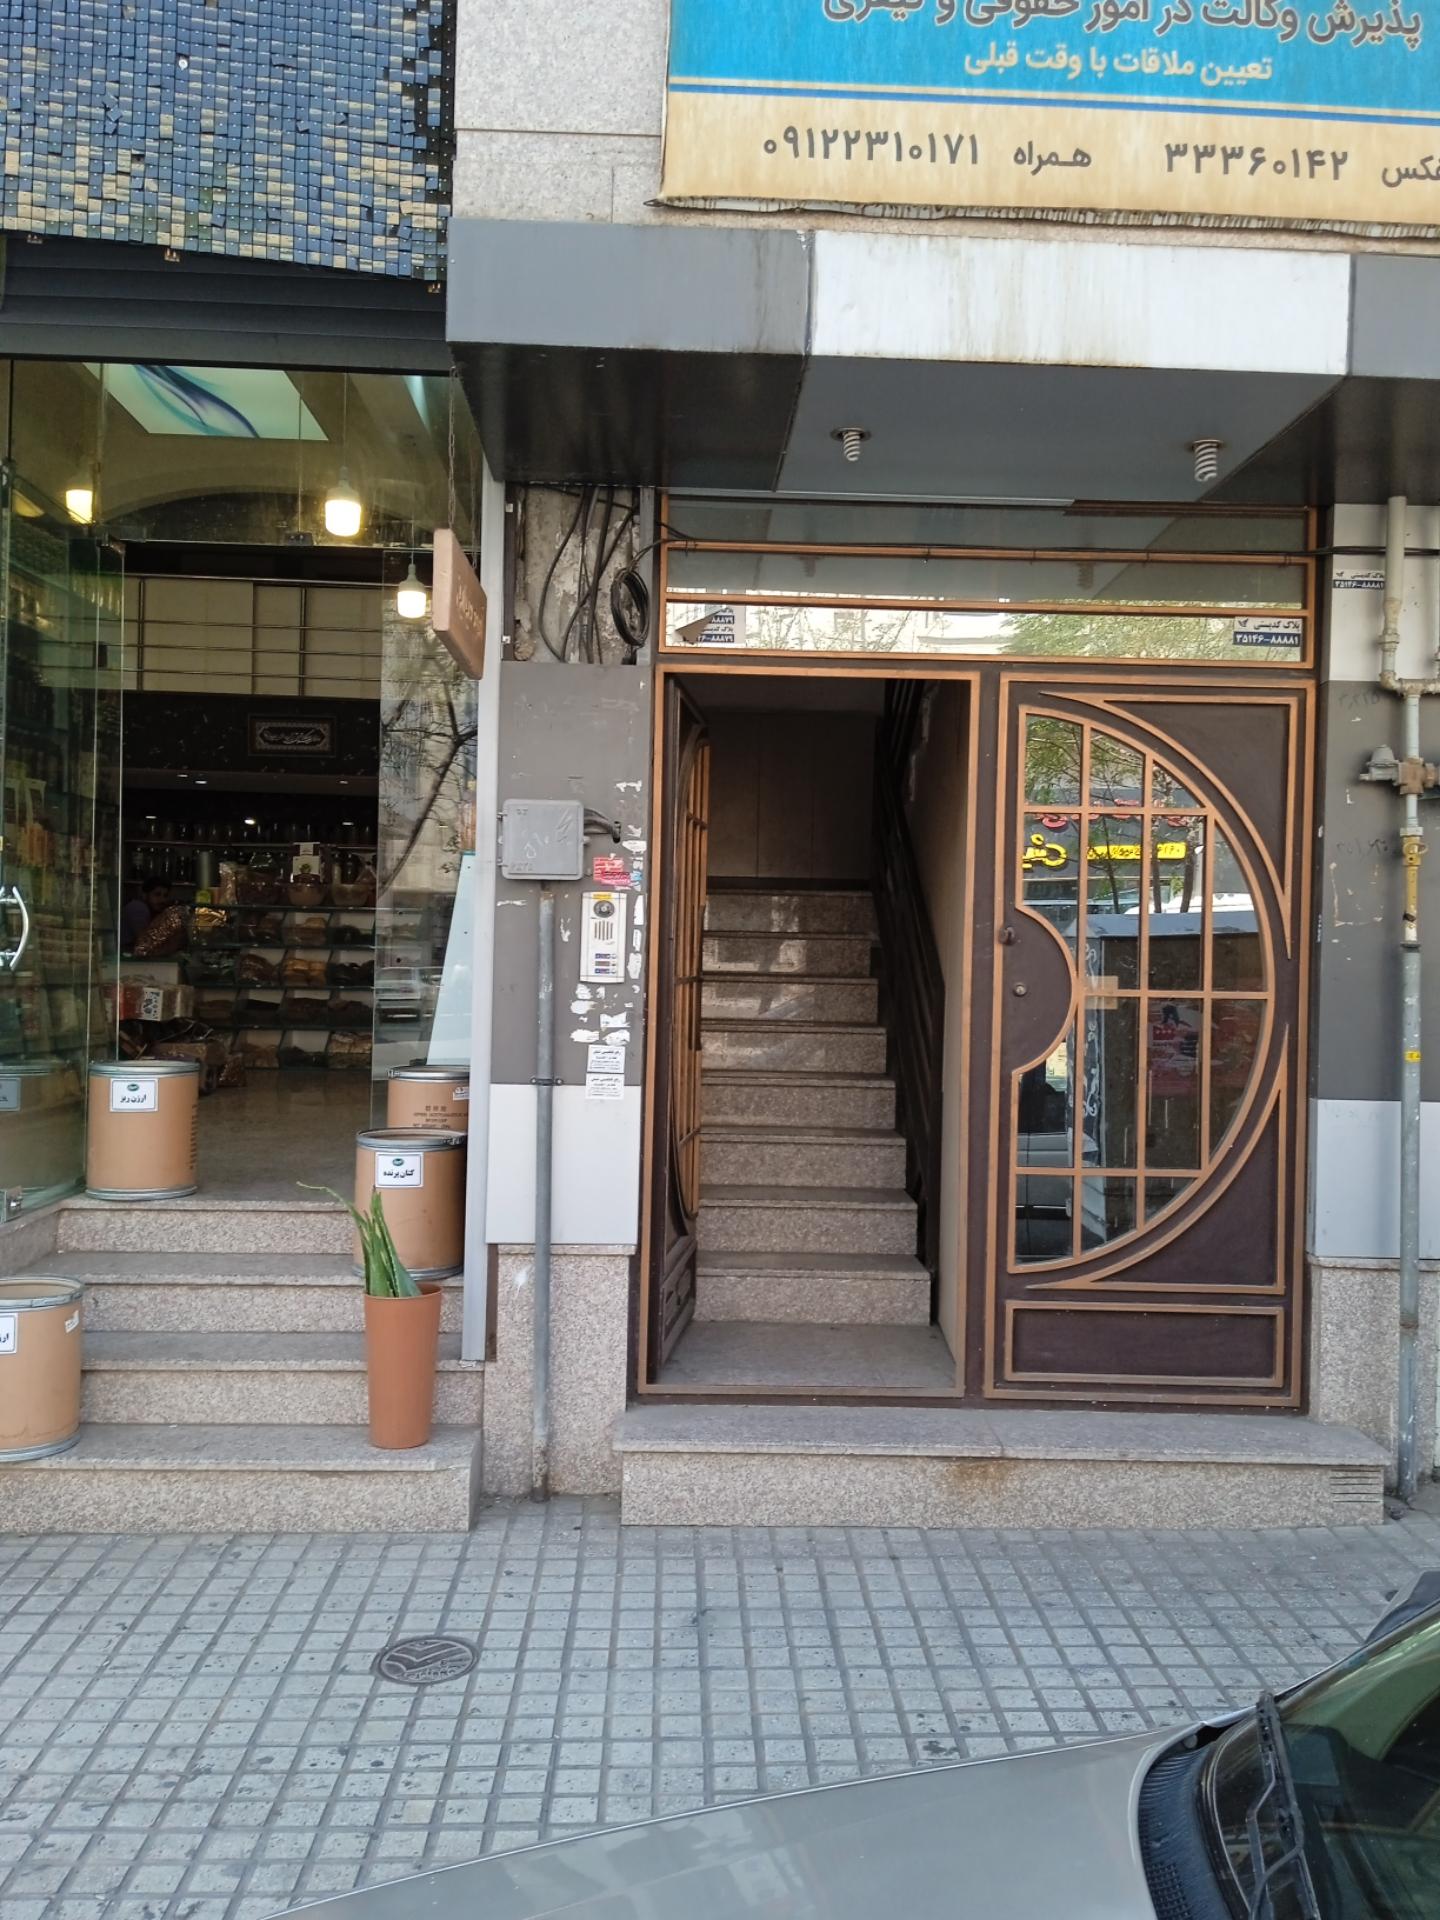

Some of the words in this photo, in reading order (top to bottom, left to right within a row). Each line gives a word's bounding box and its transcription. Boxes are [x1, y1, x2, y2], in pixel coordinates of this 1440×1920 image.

[935, 0, 956, 25] و
[1084, 0, 1149, 32] امور
[1154, 0, 1193, 35] در
[1200, 0, 1300, 42] وکالت
[1306, 0, 1422, 50] پذیرش
[964, 40, 1018, 76] قبلی
[1025, 43, 1082, 80] وقت
[1089, 46, 1107, 78] با
[1112, 48, 1195, 76] ملاقات
[1200, 57, 1273, 86] تعیین
[763, 125, 978, 165] ۰۹۱۲۲۳۱۰۱۷۱
[1013, 141, 1092, 176] همراه
[1165, 143, 1348, 181] ۳۳۳۶۰۱۴۲
[1283, 620, 1300, 632] پلاک
